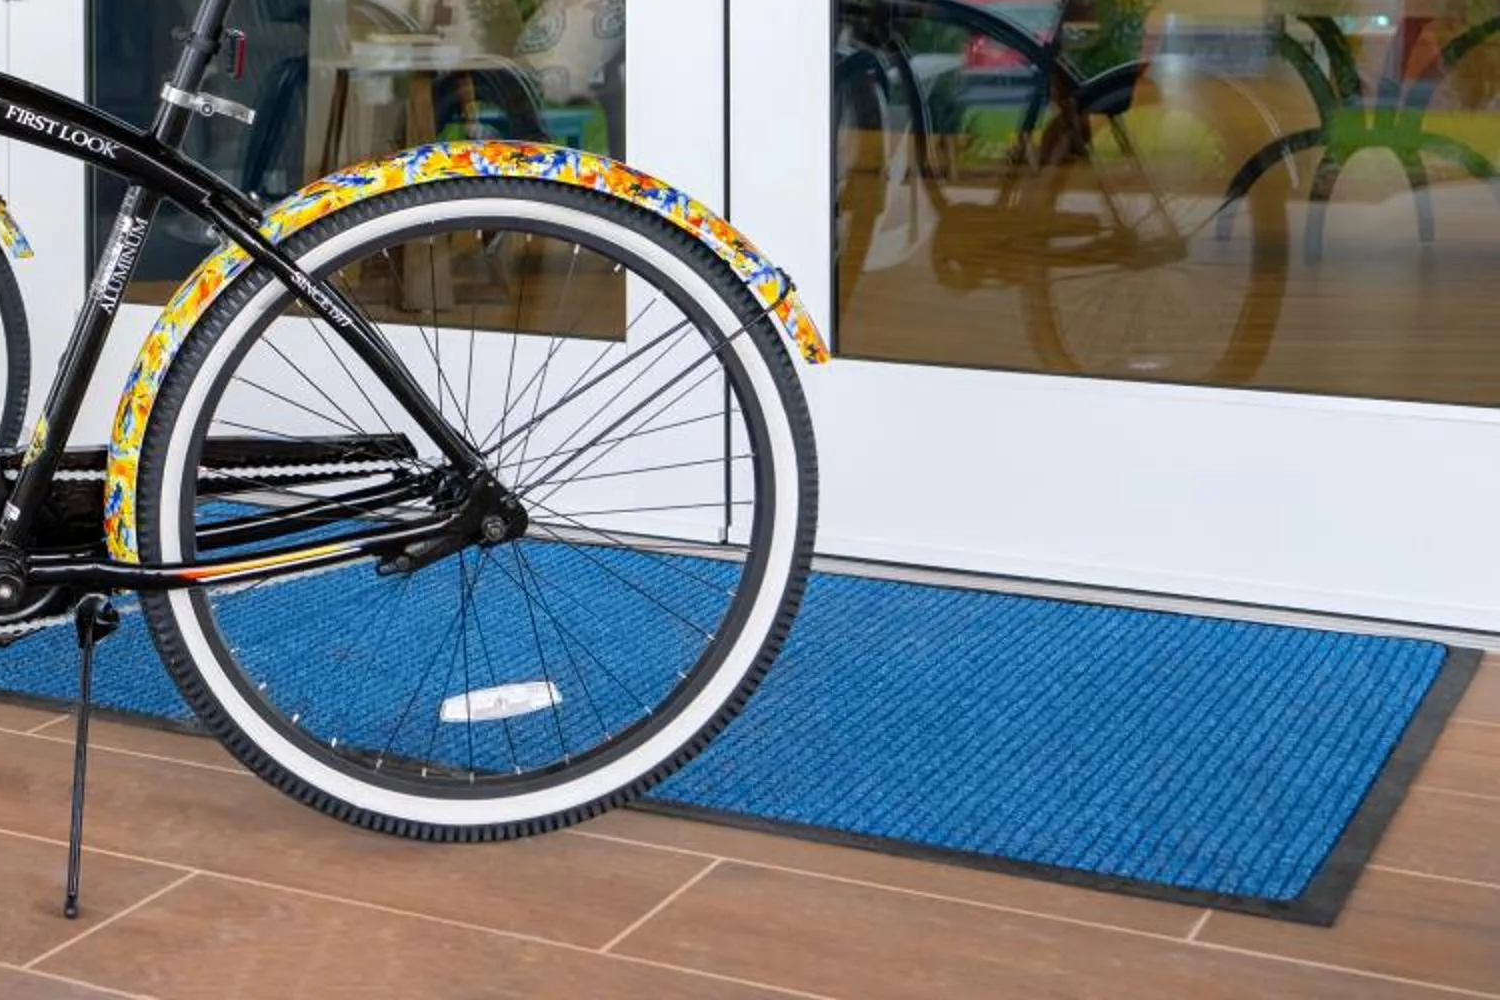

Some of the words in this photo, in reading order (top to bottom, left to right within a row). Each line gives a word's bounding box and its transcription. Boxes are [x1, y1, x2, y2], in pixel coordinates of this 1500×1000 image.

[4, 104, 59, 135] FIRST
[59, 125, 120, 159] LOOK
[100, 215, 149, 316] ALUMINUM
